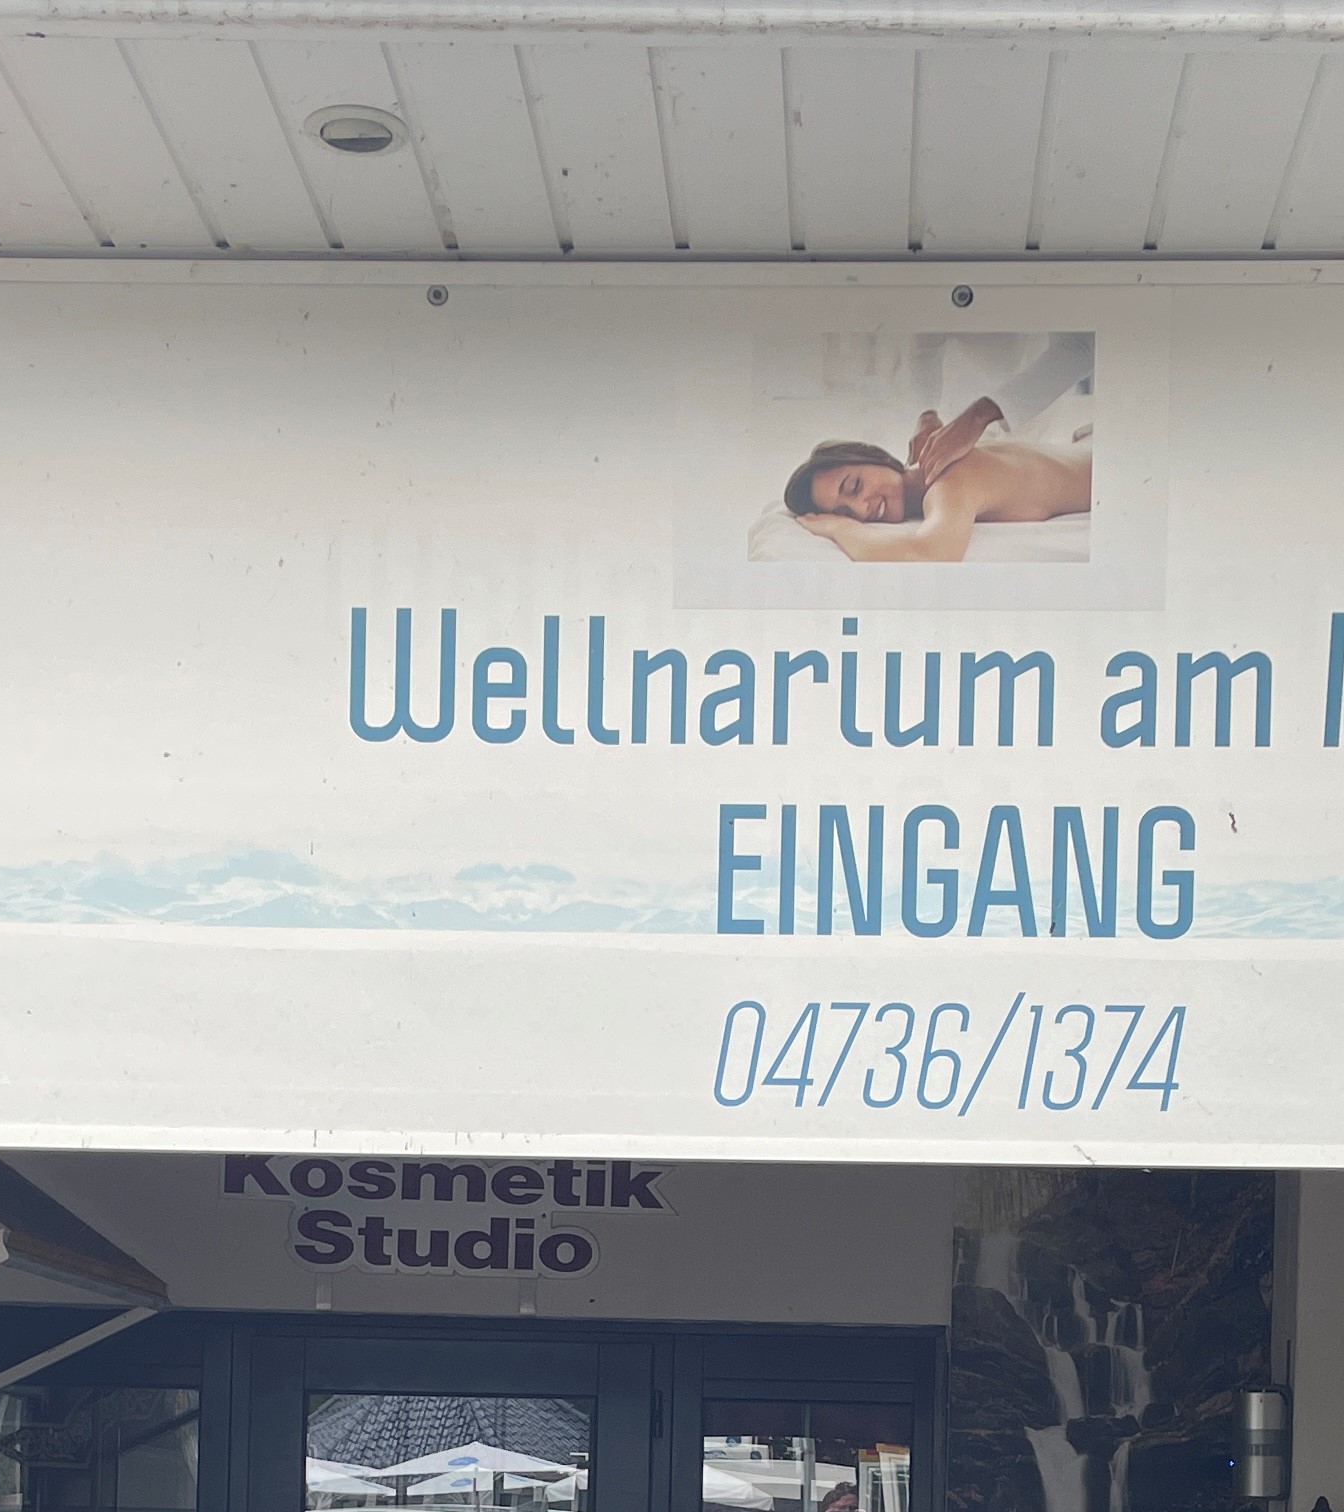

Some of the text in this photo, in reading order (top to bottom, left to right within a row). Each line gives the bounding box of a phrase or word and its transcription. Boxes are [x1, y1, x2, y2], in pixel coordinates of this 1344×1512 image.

[348, 605, 1055, 750] Wellnarium
[1099, 648, 1273, 750] am
[716, 802, 1197, 942] EINGANG
[712, 992, 1188, 1117] 04736/1374
[225, 1156, 664, 1209] Kosmetik
[294, 1209, 593, 1272] Studio
